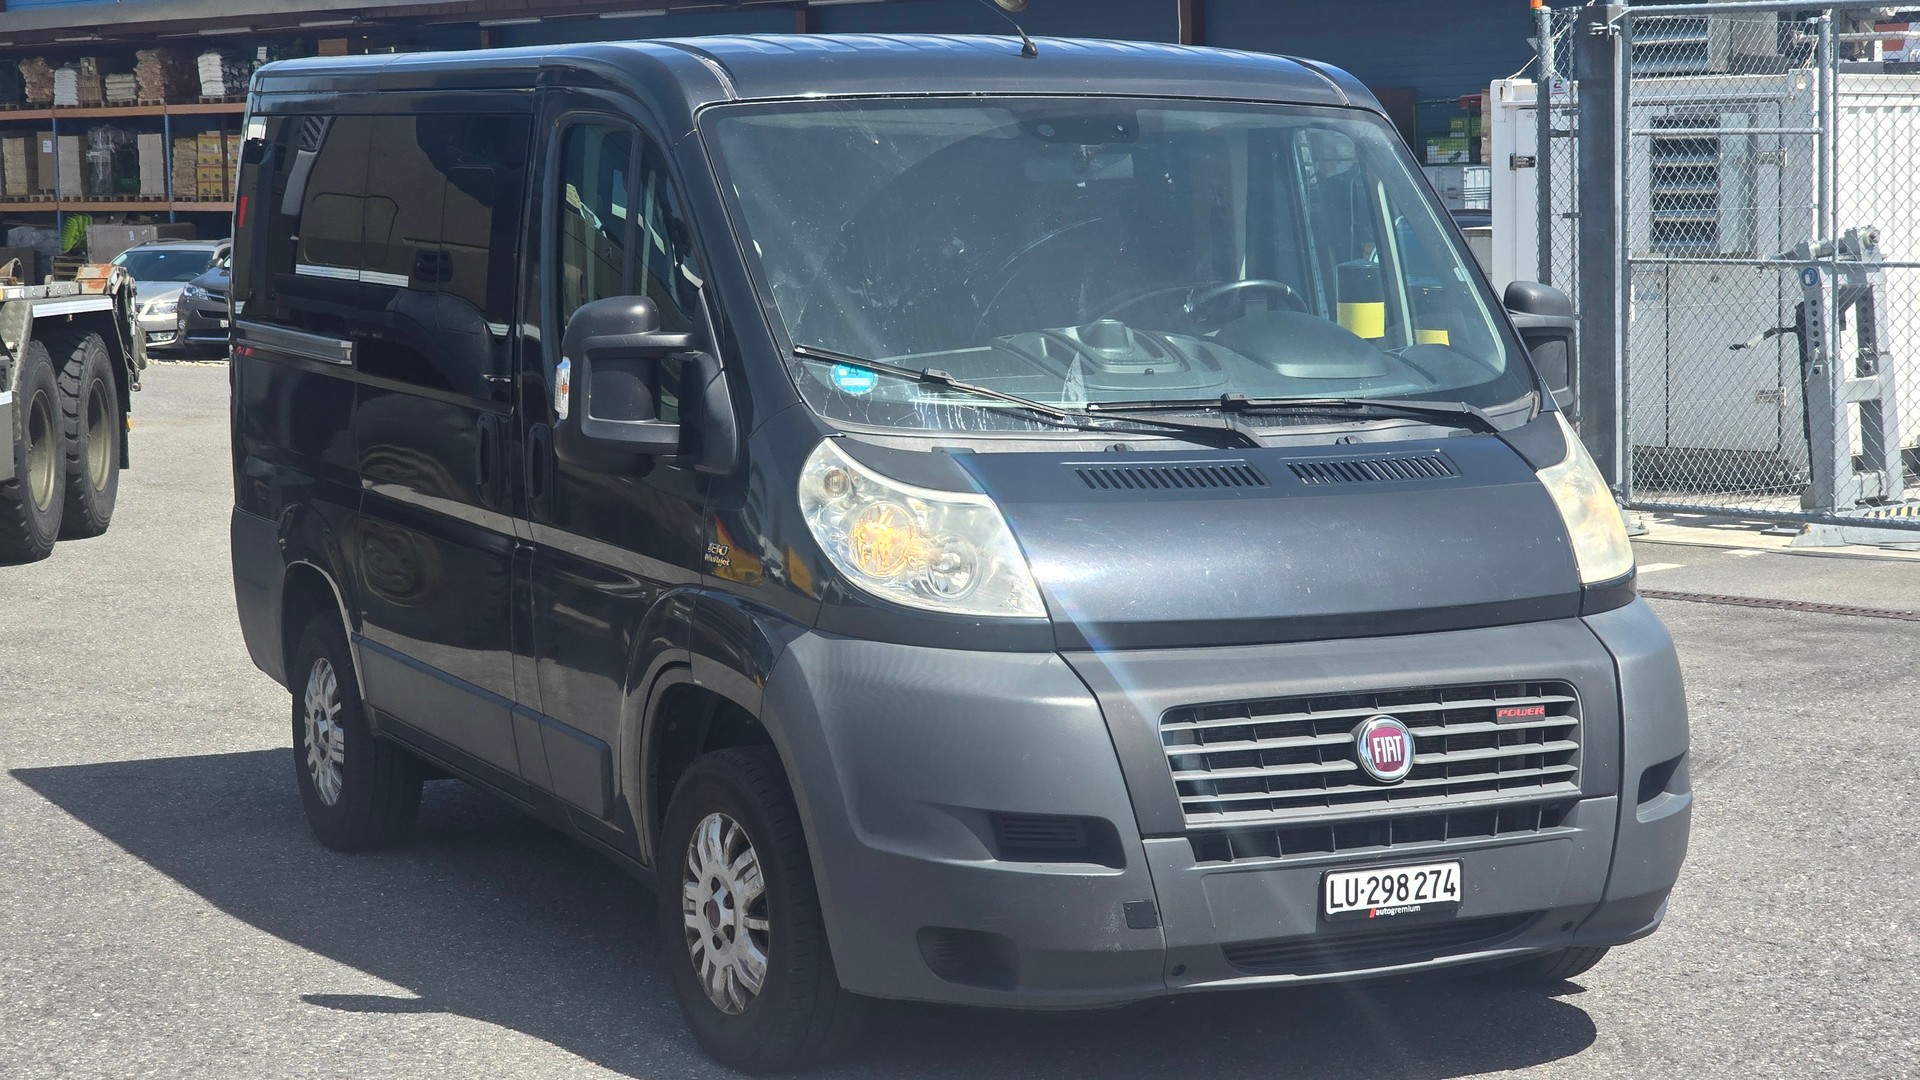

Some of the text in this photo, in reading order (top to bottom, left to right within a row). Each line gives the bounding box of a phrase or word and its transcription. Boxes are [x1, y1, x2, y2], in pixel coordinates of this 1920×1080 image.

[1498, 705, 1544, 718] POWER
[1373, 735, 1402, 764] FIAT
[1375, 905, 1421, 916] autogremium
